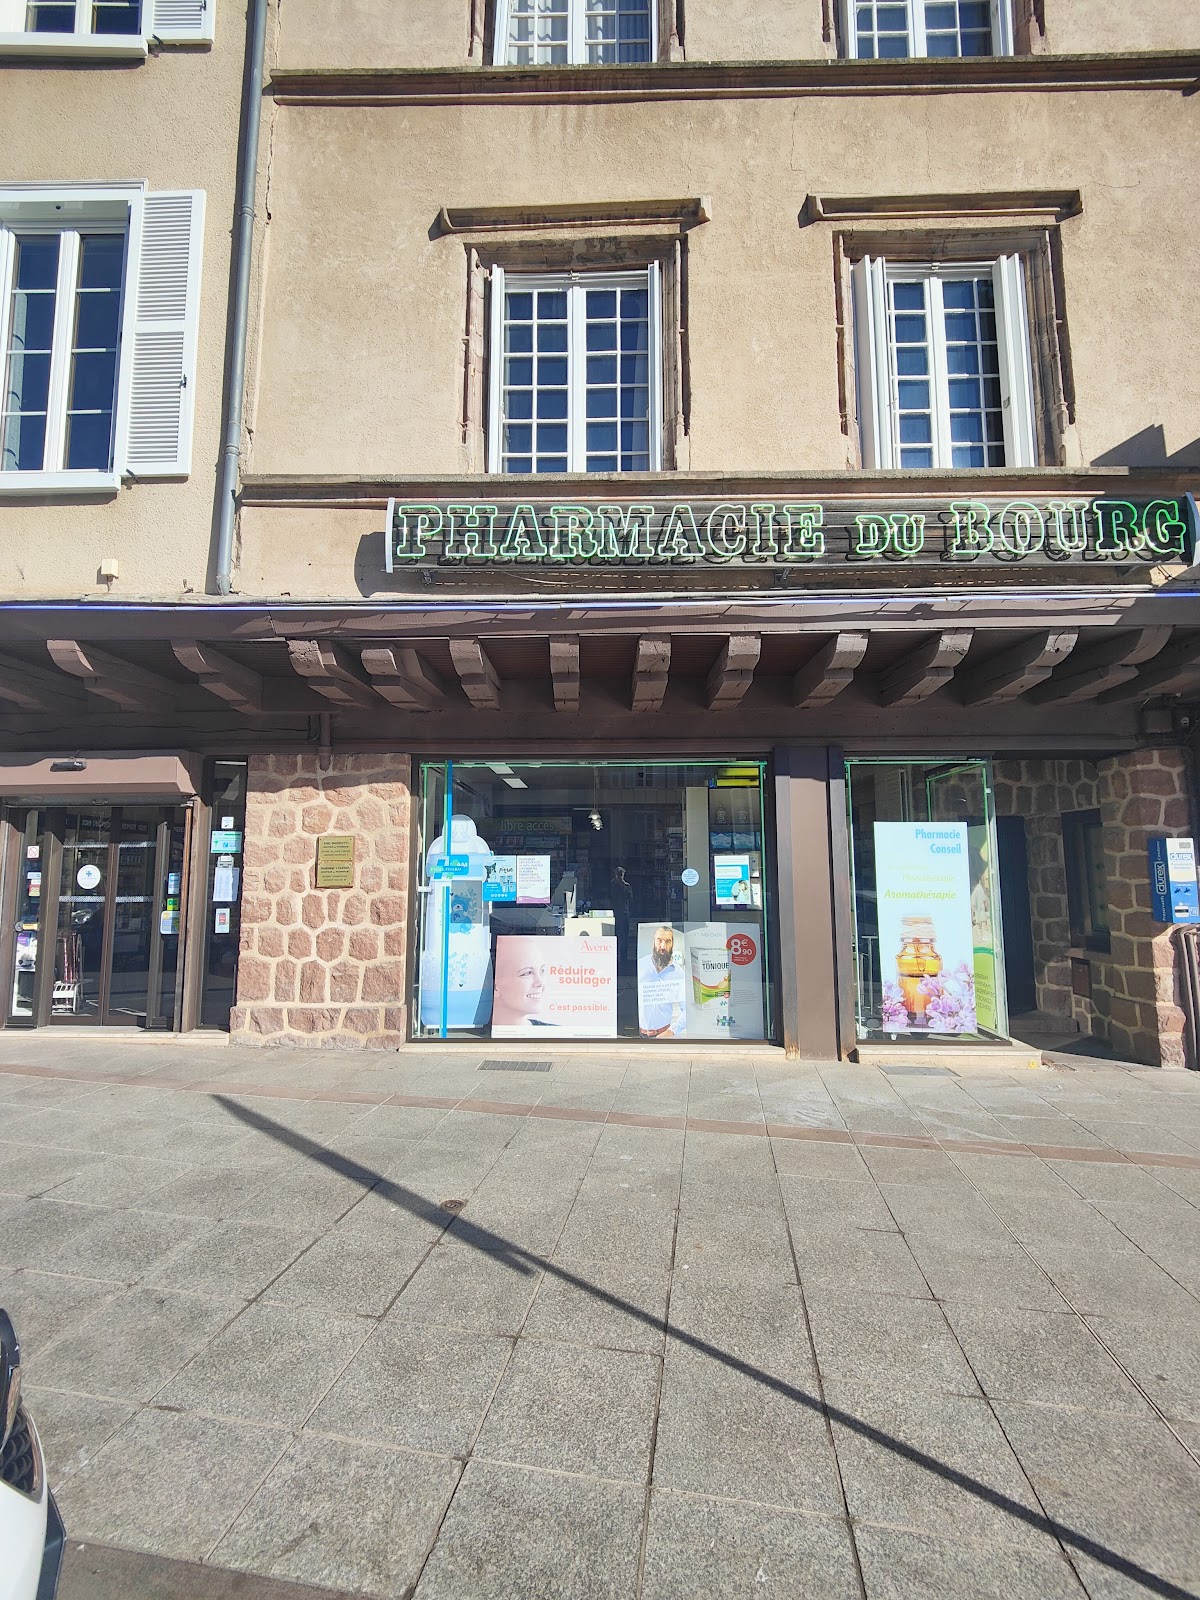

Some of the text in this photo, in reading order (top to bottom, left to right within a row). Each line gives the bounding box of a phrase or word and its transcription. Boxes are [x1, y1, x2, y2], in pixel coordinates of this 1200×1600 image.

[397, 500, 1187, 558] PHARMACIE DU BOURG
[501, 819, 555, 831] libre accès
[915, 829, 961, 839] Pharmacie
[930, 843, 961, 854] Conseil
[1156, 863, 1166, 893] durex
[884, 890, 957, 900] Aromathérapie
[580, 940, 612, 952] Avène
[550, 965, 596, 976] Réduire
[559, 975, 611, 987] soulager
[549, 1003, 610, 1012] C'est possible.
